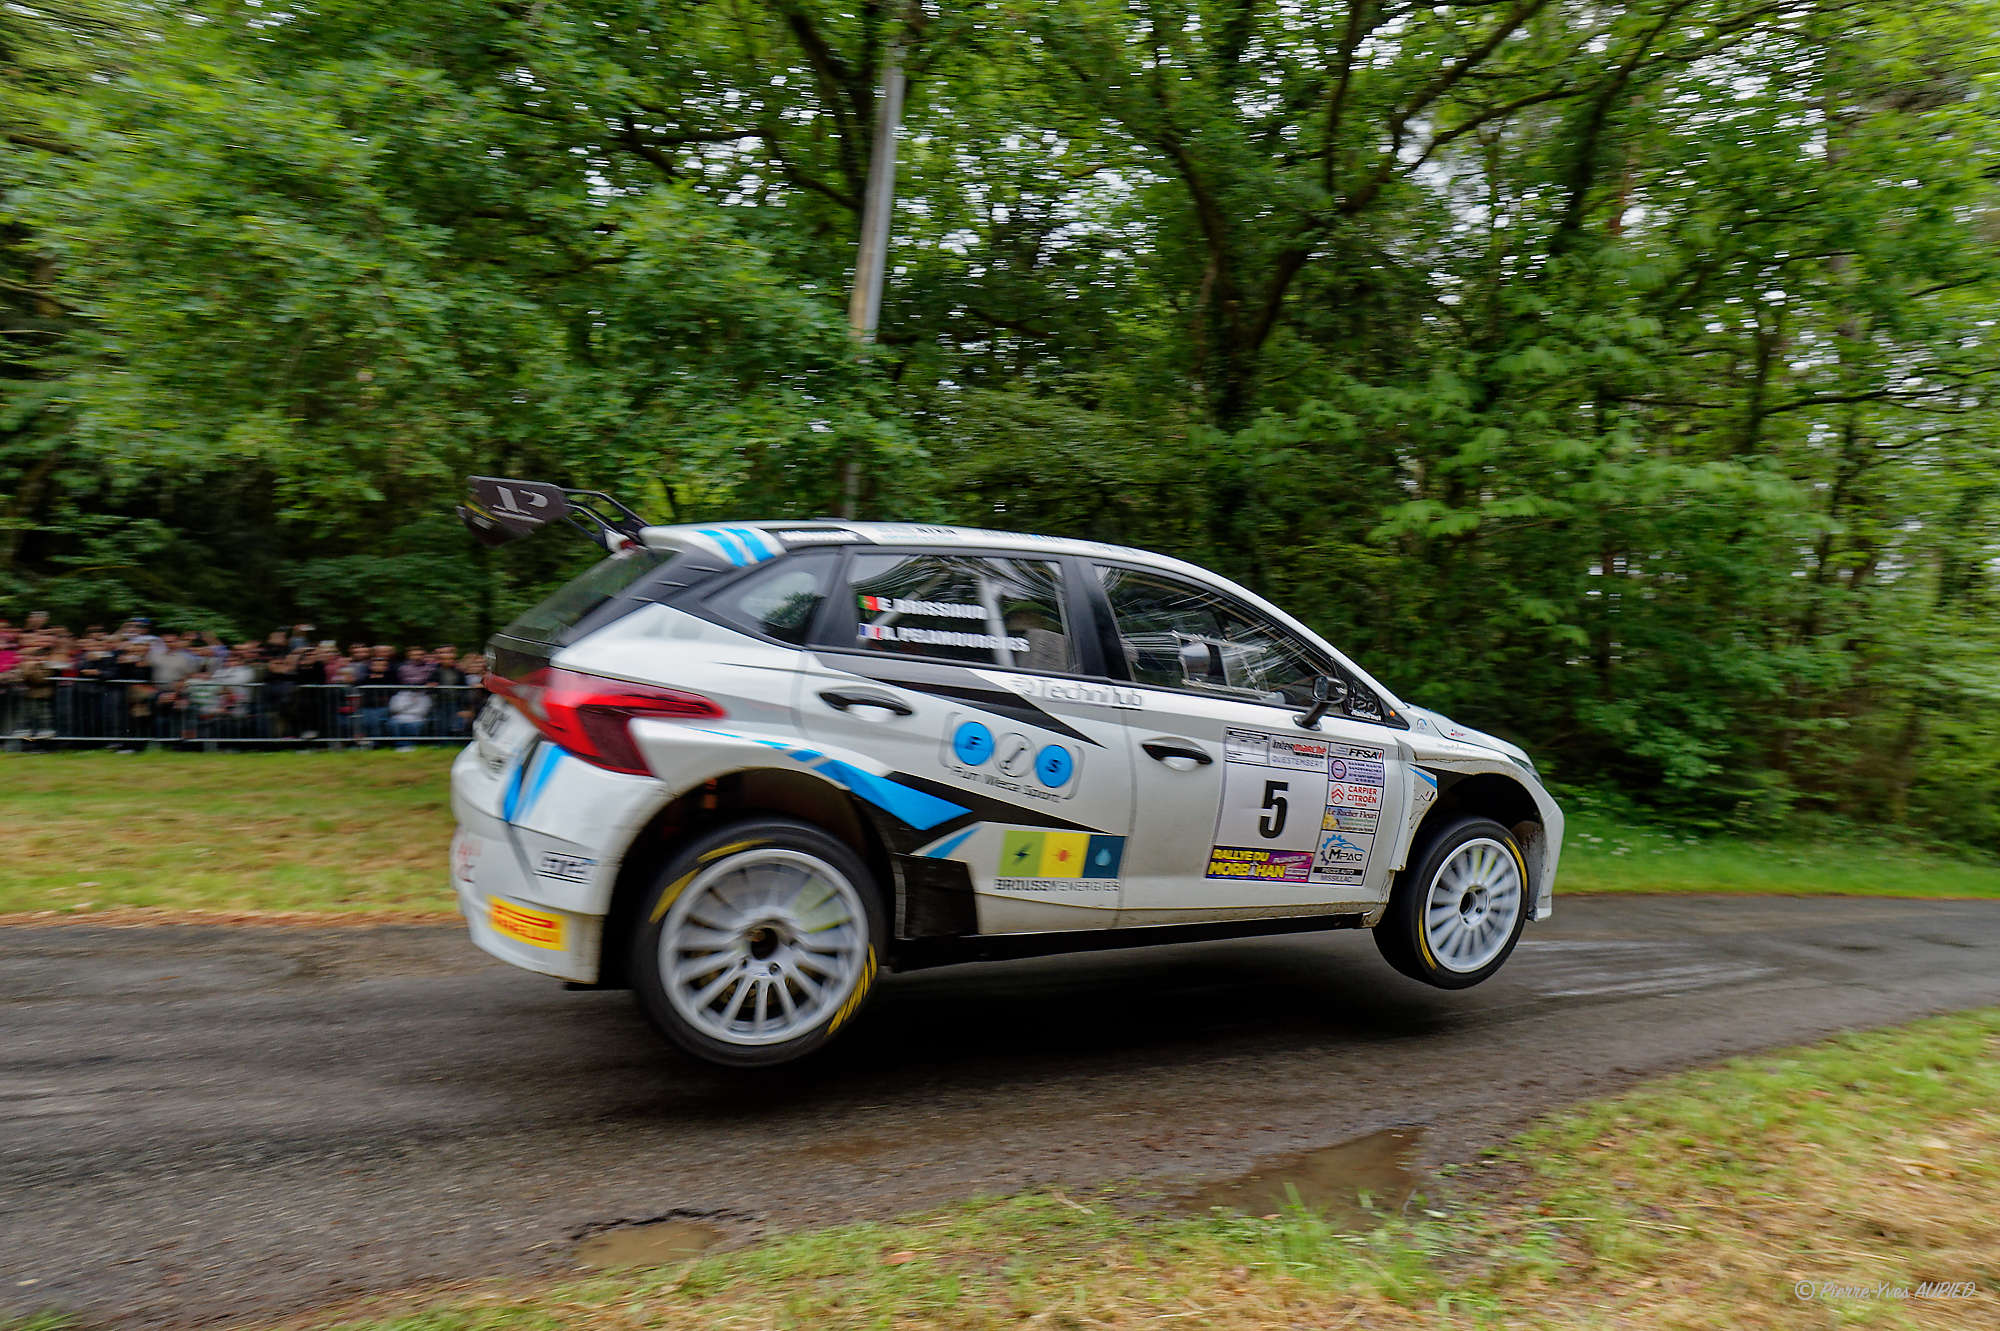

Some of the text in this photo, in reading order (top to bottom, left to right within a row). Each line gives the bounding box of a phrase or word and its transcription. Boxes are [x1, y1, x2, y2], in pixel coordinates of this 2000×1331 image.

[1349, 748, 1378, 760] FFSA
[1347, 785, 1378, 795] CARPIER
[1259, 780, 1289, 839] 5
[1211, 849, 1255, 861] RALLYE
[1253, 851, 1271, 862] DU
